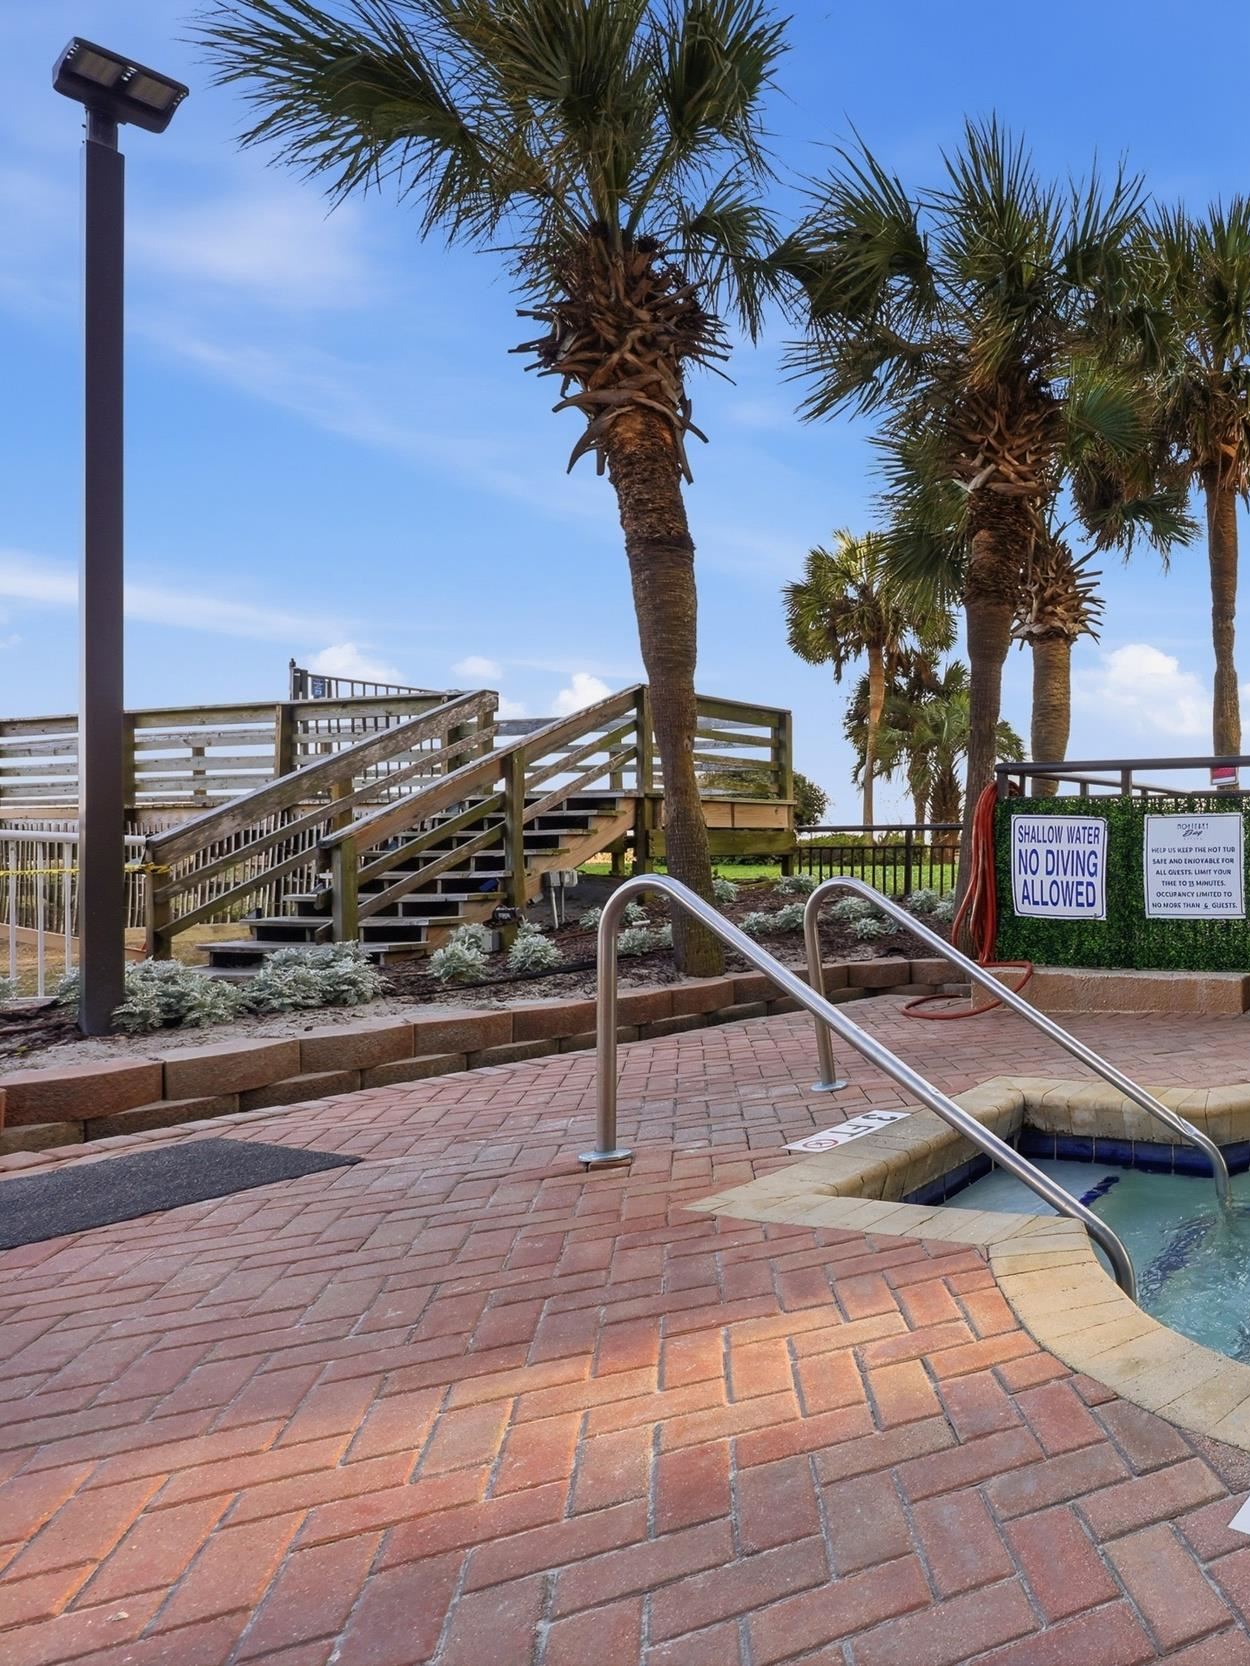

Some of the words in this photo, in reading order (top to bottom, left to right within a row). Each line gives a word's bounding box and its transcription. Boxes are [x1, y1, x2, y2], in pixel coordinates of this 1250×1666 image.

[1018, 825, 1063, 843] SHALLOW
[1066, 825, 1100, 844] WATER
[1018, 848, 1039, 876] NO
[1045, 849, 1098, 878] DIVING
[1022, 879, 1096, 907] ALLOWED
